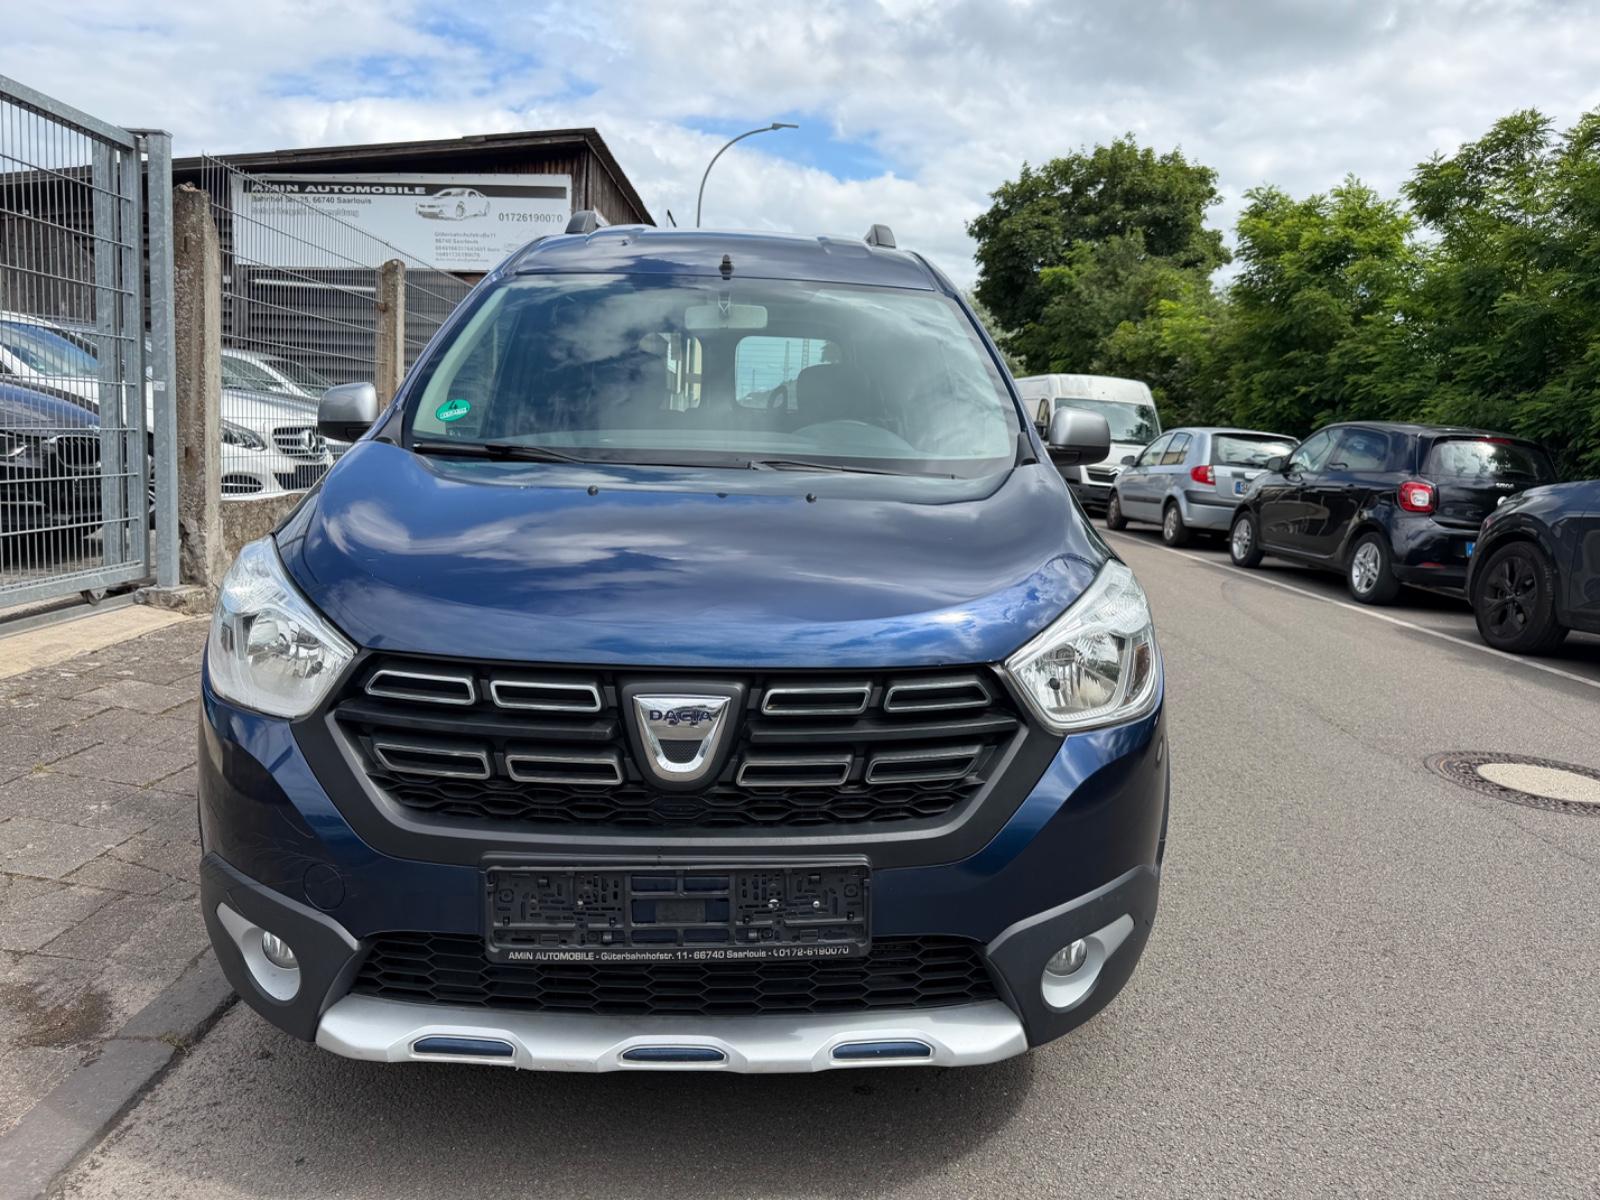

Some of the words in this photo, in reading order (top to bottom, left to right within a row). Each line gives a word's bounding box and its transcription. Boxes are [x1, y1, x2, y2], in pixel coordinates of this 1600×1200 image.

[304, 184, 426, 195] AUTOMOBILE
[499, 212, 563, 223] 01726190070
[649, 709, 713, 721] DACIA
[508, 951, 533, 960] AMIN
[535, 951, 595, 960] AUTOMOBILE
[601, 951, 674, 961] Güterbahnhofstr.
[693, 950, 725, 960] 66740
[726, 949, 767, 959] Saarlouis
